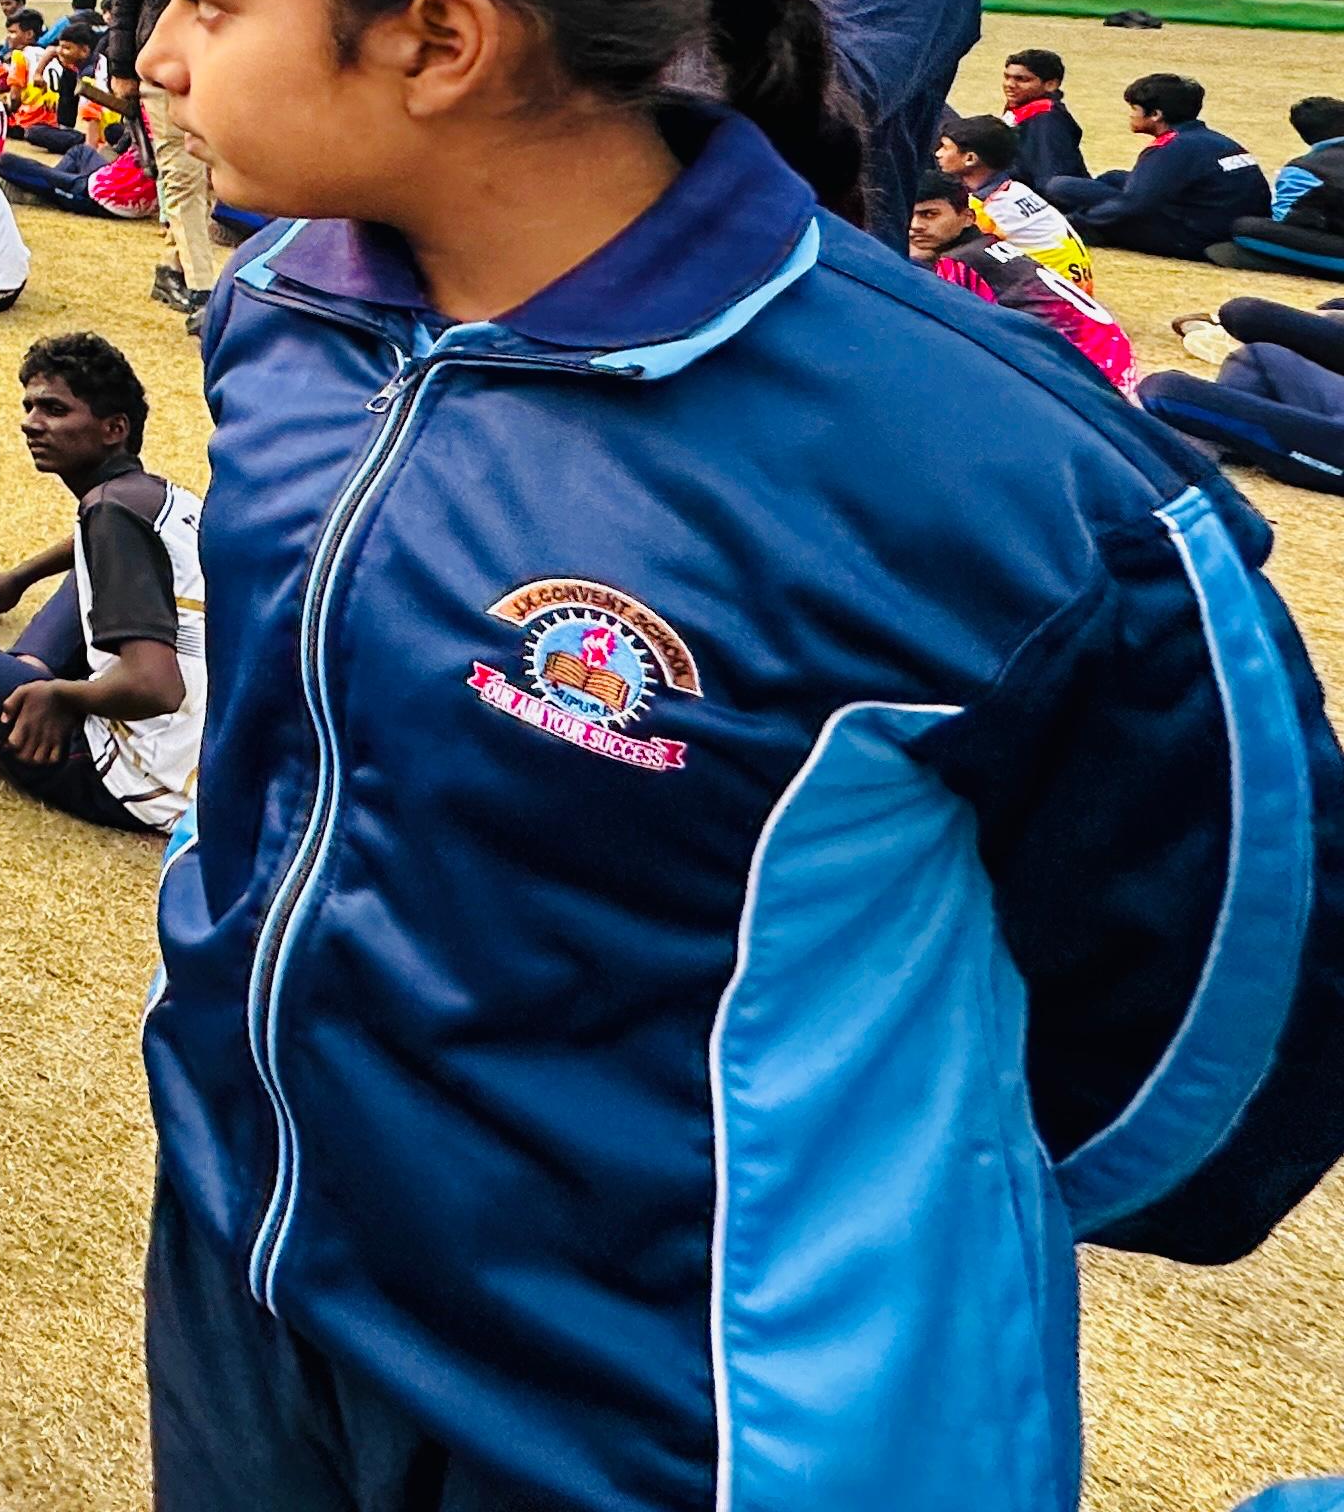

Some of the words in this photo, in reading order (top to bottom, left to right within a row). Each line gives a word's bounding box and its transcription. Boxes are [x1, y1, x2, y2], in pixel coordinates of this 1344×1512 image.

[539, 586, 632, 616] CONVENT
[543, 710, 587, 744] YOUR
[588, 728, 664, 766] SUCCESS
